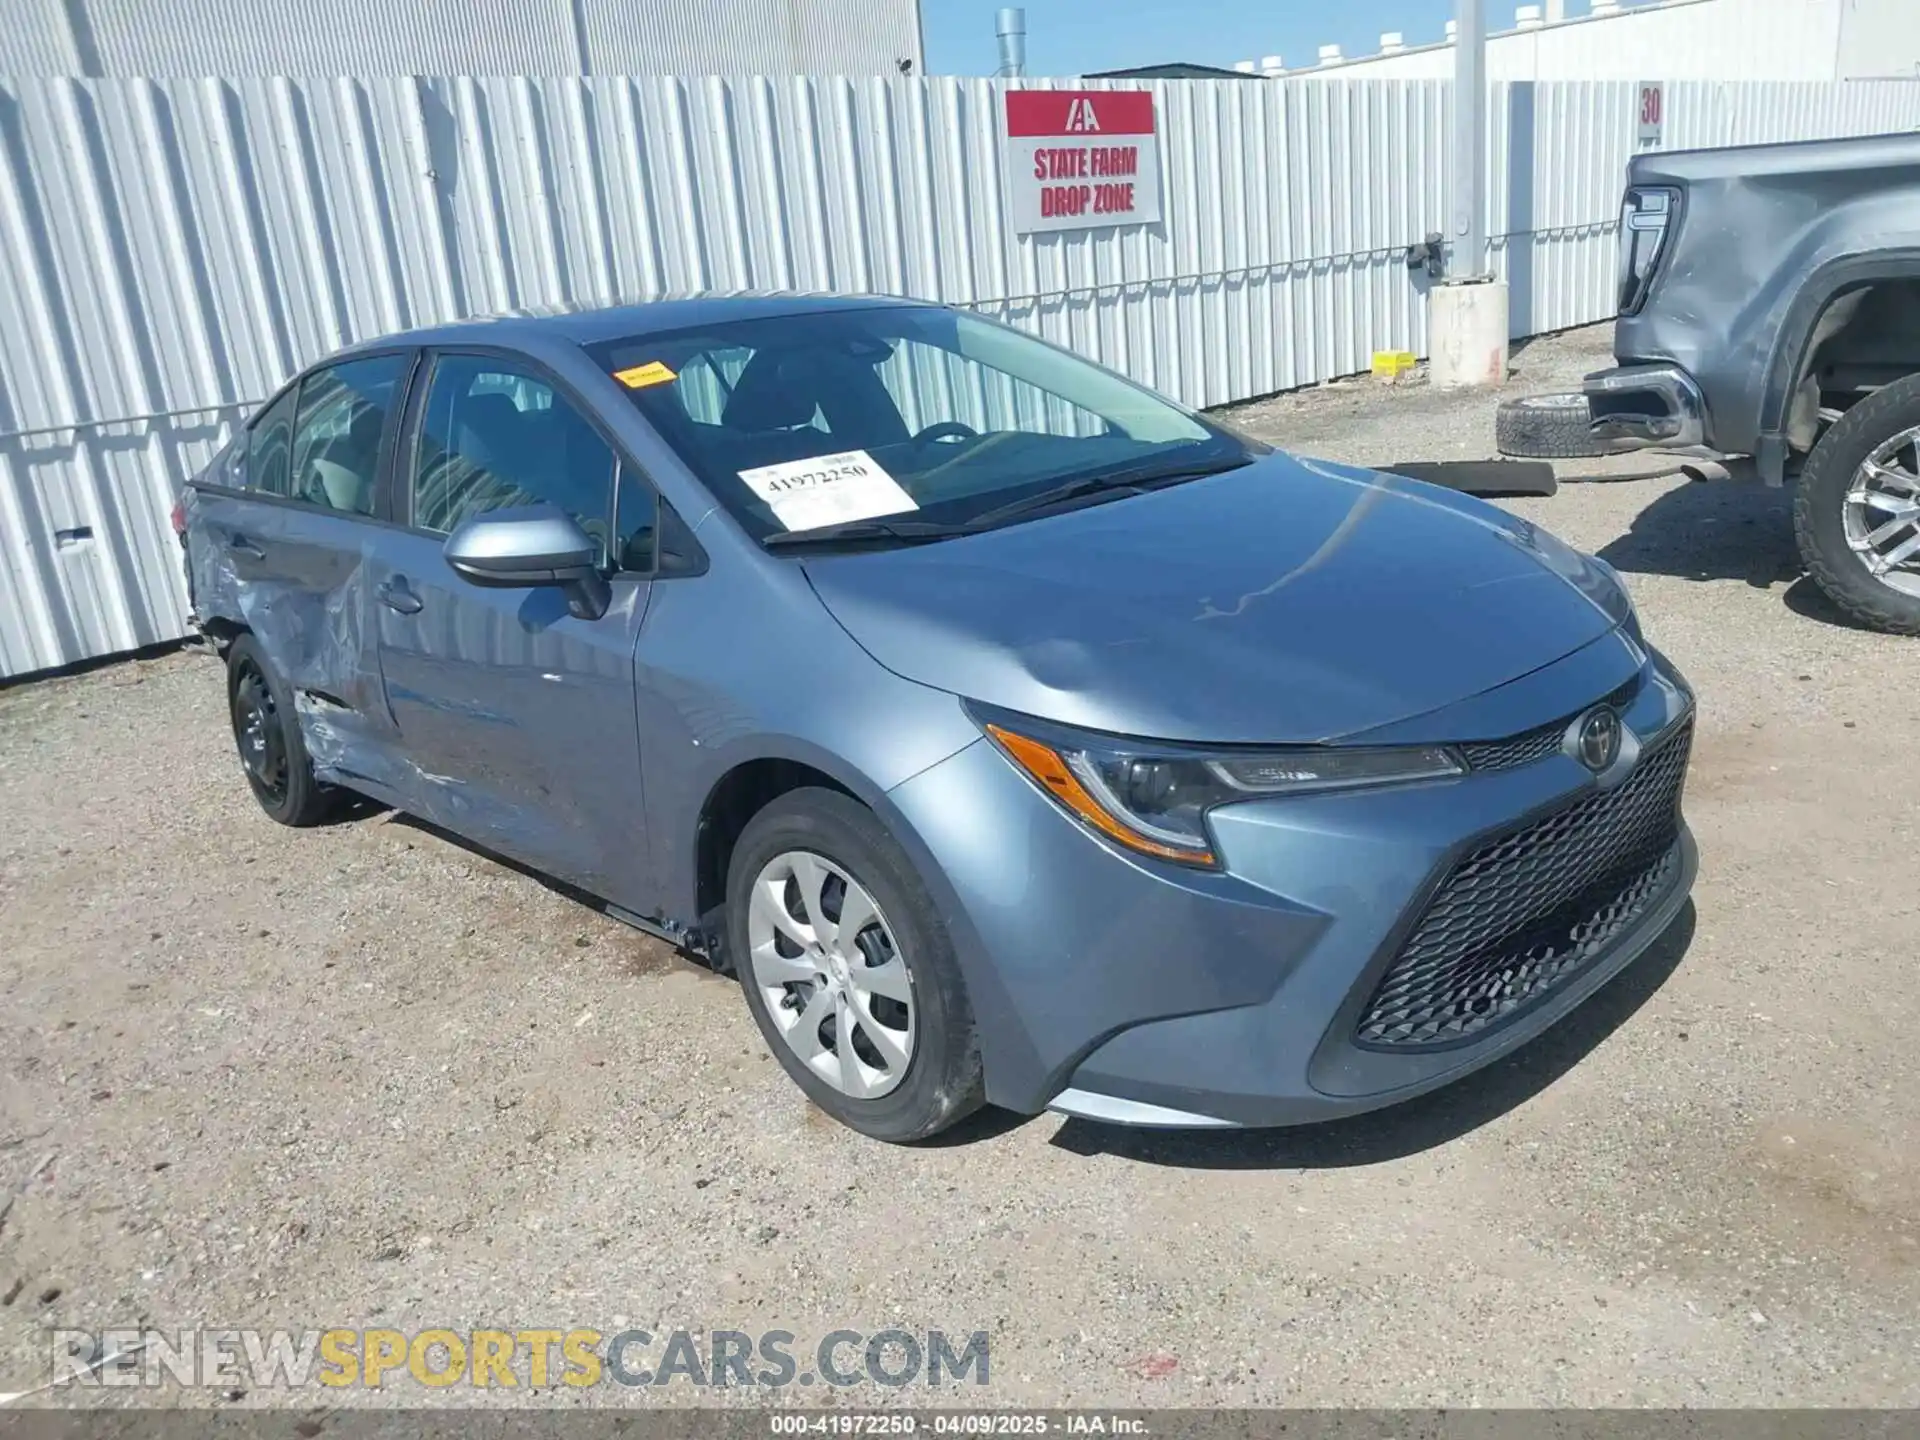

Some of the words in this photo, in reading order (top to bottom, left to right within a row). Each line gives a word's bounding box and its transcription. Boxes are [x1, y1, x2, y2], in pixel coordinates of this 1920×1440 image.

[1641, 87, 1660, 124] 30
[1034, 147, 1088, 180] STATE
[1091, 146, 1137, 177] FARM
[1041, 185, 1090, 218] DROP
[1094, 182, 1134, 213] ZONE
[768, 464, 868, 493] 41972250
